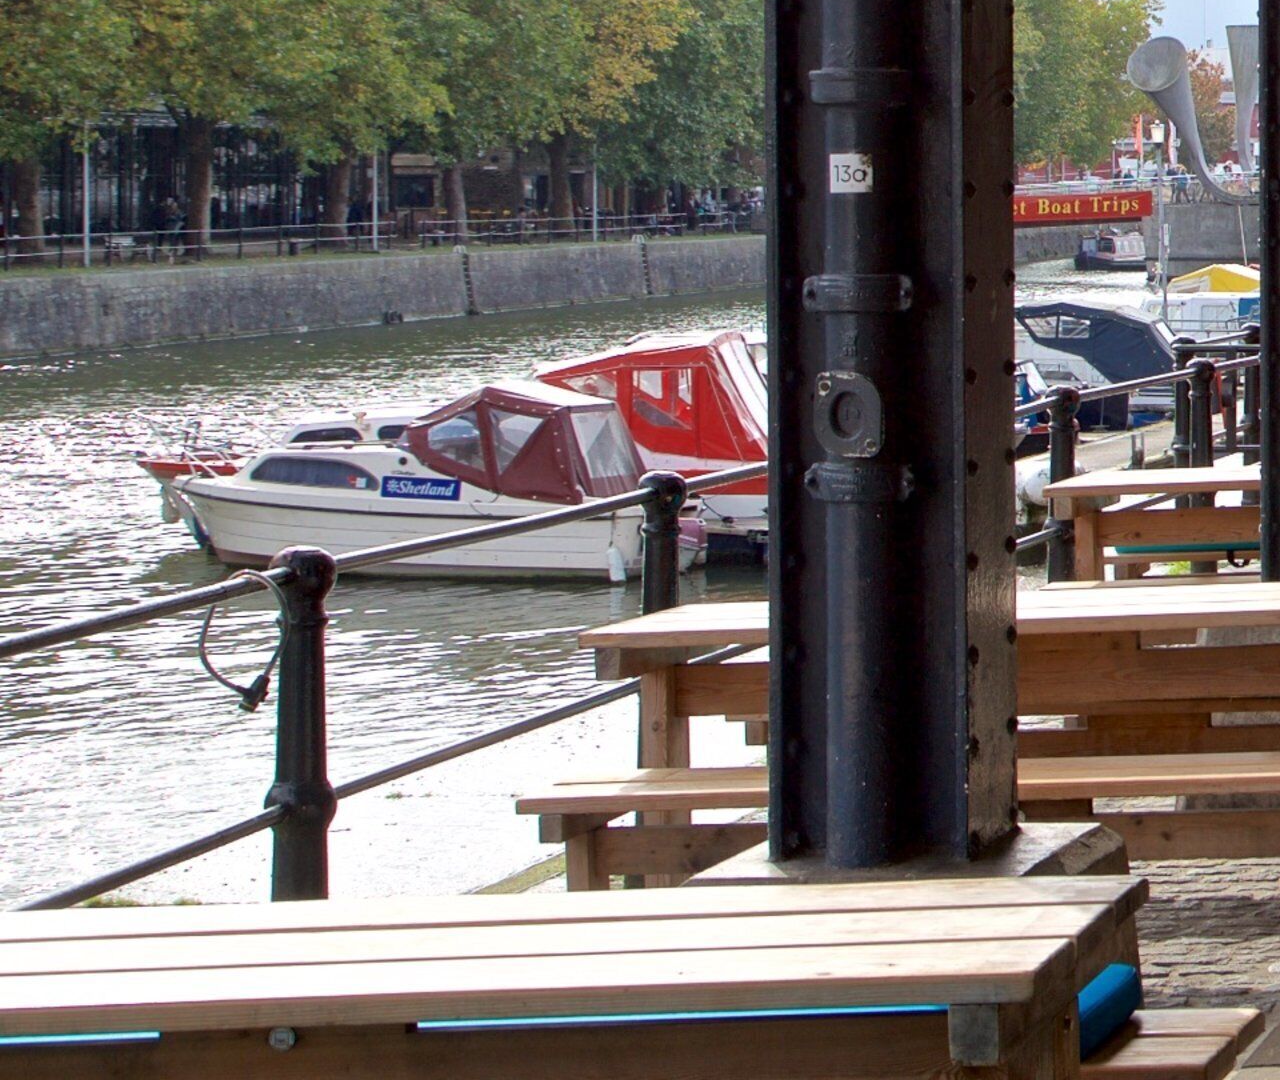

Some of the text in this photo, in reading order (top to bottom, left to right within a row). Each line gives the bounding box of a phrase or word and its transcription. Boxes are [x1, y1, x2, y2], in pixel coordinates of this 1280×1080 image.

[832, 164, 868, 184] 13a
[1038, 197, 1081, 216] Boat
[1089, 195, 1140, 216] Trips
[398, 480, 456, 496] Shetland
